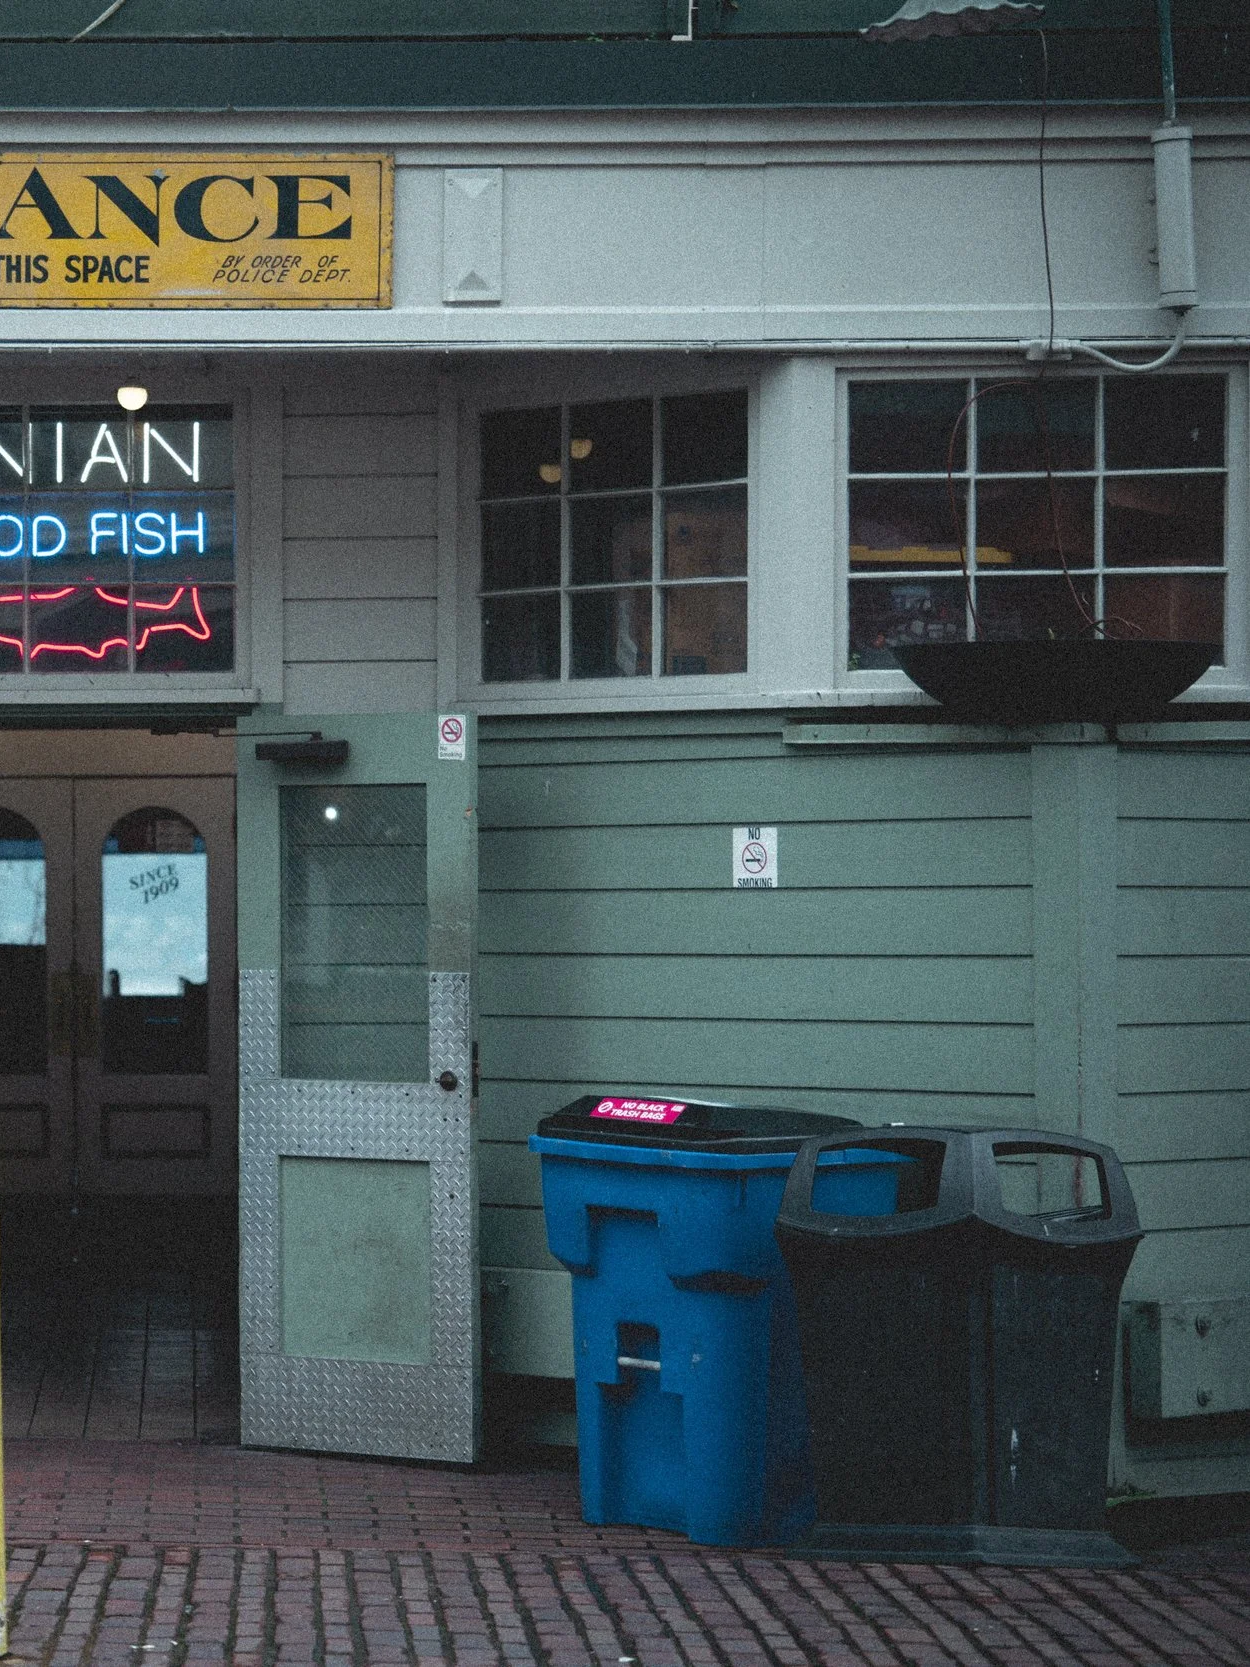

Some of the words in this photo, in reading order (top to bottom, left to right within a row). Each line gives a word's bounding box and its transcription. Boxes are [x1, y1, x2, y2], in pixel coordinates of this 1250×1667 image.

[64, 254, 150, 284] SPACE
[221, 255, 245, 268] BY
[251, 255, 302, 269] ORDER
[317, 255, 339, 268] OF
[212, 269, 290, 283] POLICE
[91, 511, 206, 555] FISH
[748, 827, 761, 840] NO
[129, 864, 178, 890] SINCE
[737, 877, 773, 888] SMOKING
[143, 876, 180, 904] 1909
[621, 1101, 635, 1109] NO
[637, 1103, 667, 1111] BLACK
[610, 1109, 639, 1117] TRASH
[640, 1111, 666, 1120] BAGS
